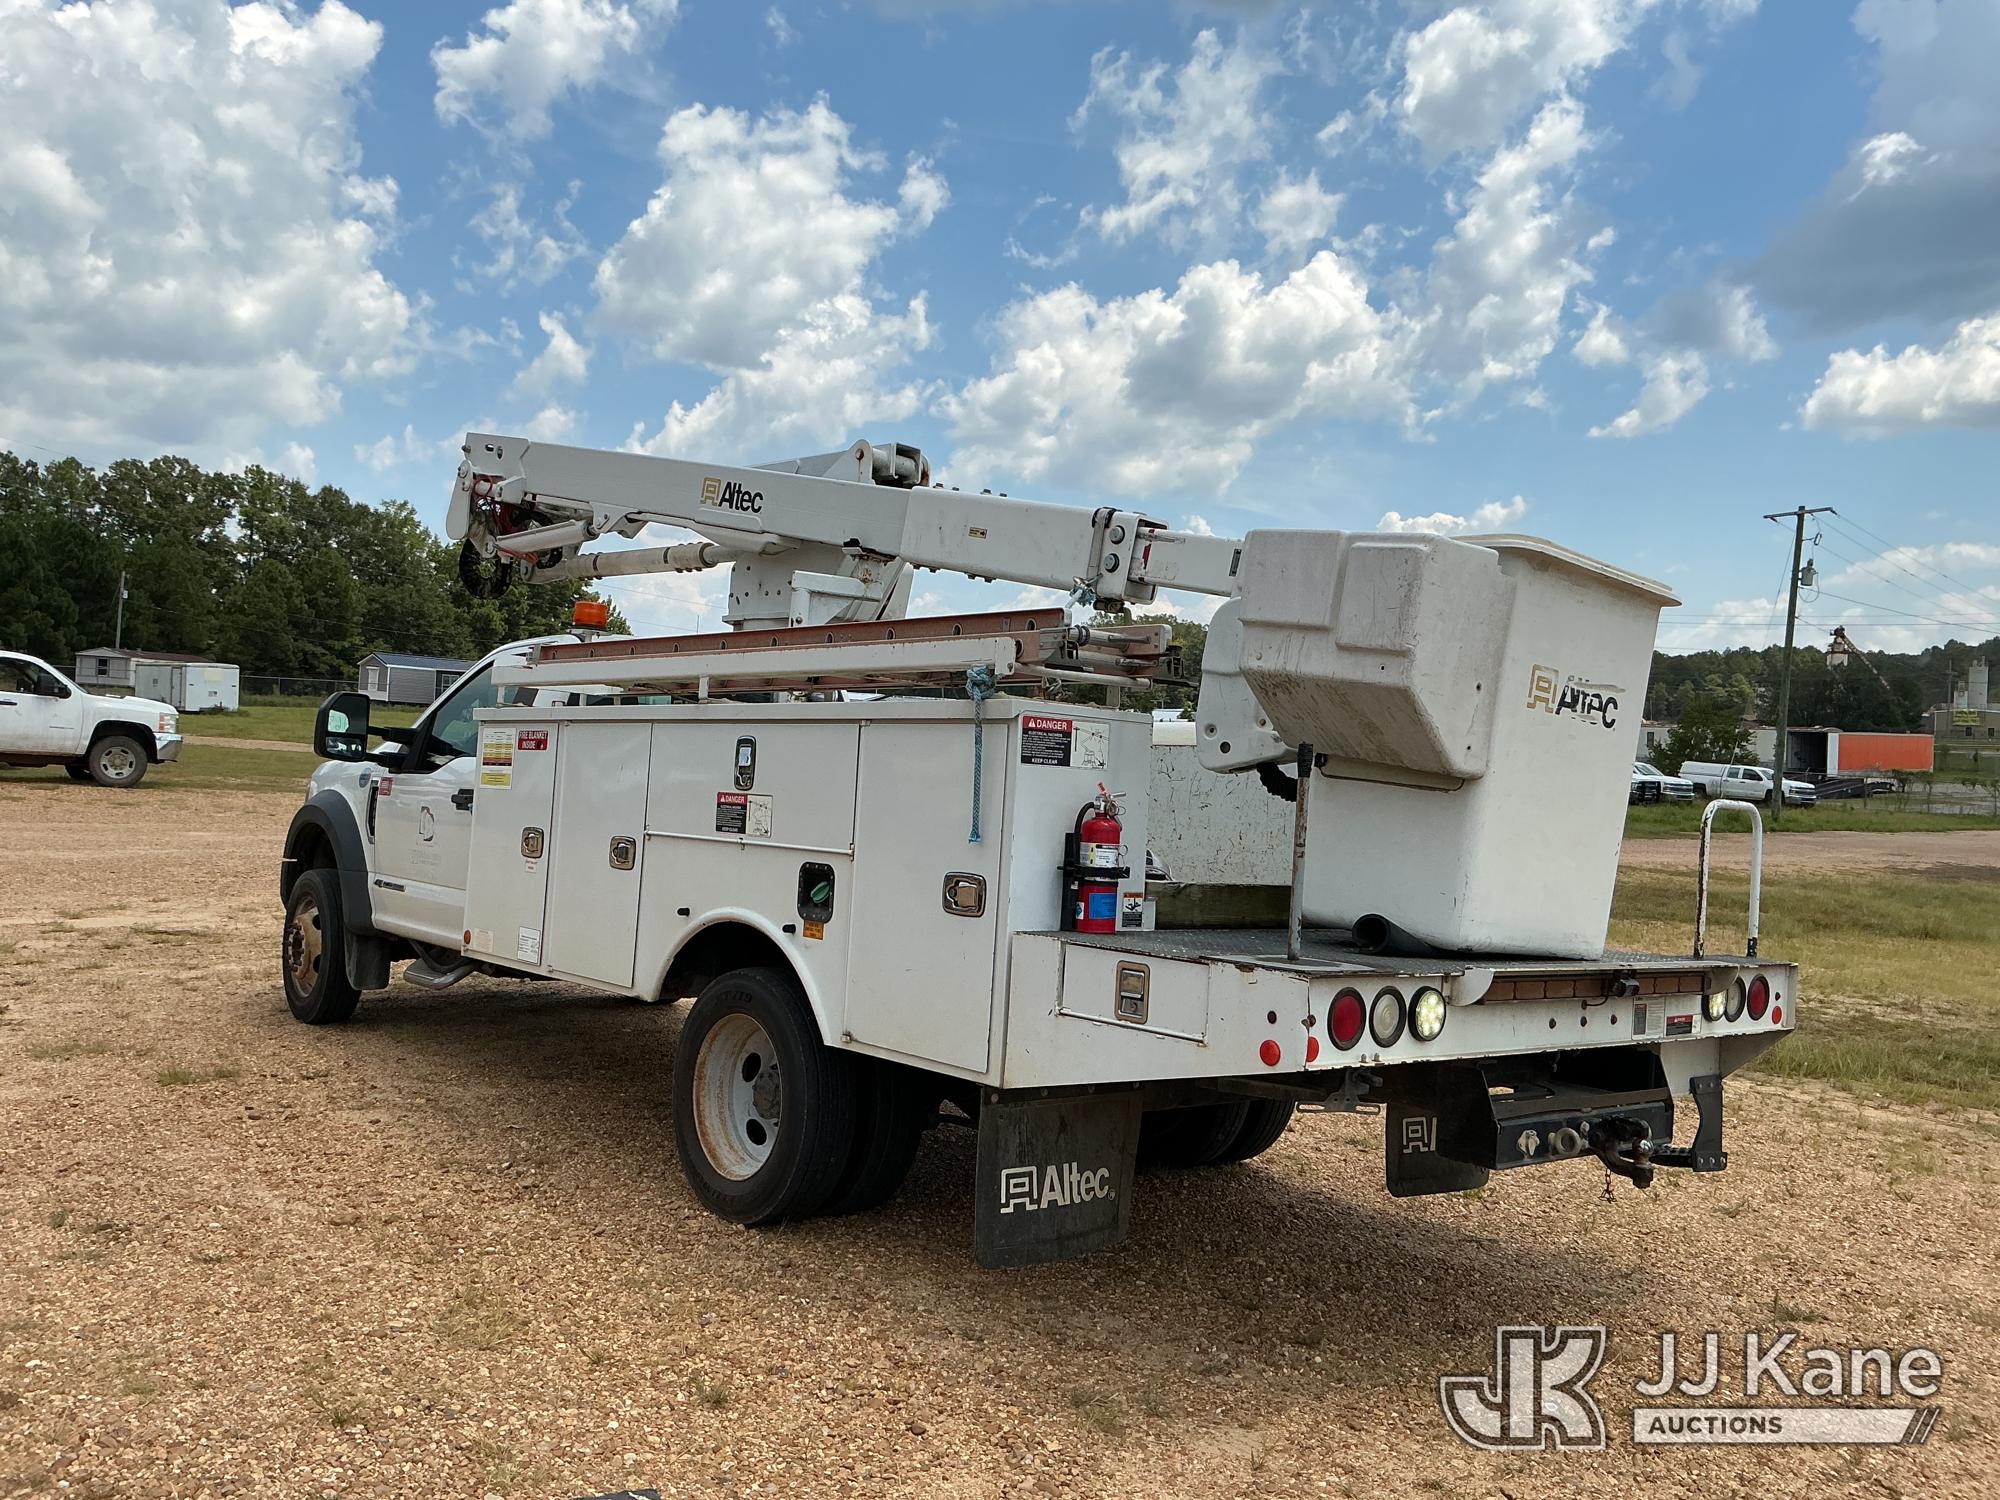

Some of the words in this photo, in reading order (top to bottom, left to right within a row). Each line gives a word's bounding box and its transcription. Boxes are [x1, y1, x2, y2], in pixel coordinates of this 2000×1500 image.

[718, 481, 764, 514] Altec
[1036, 719, 1068, 731] DANGER
[528, 731, 548, 740] BLANKET
[521, 740, 536, 749] INSIDE
[725, 795, 745, 804] DANGER
[1040, 1162, 1110, 1209] Altec
